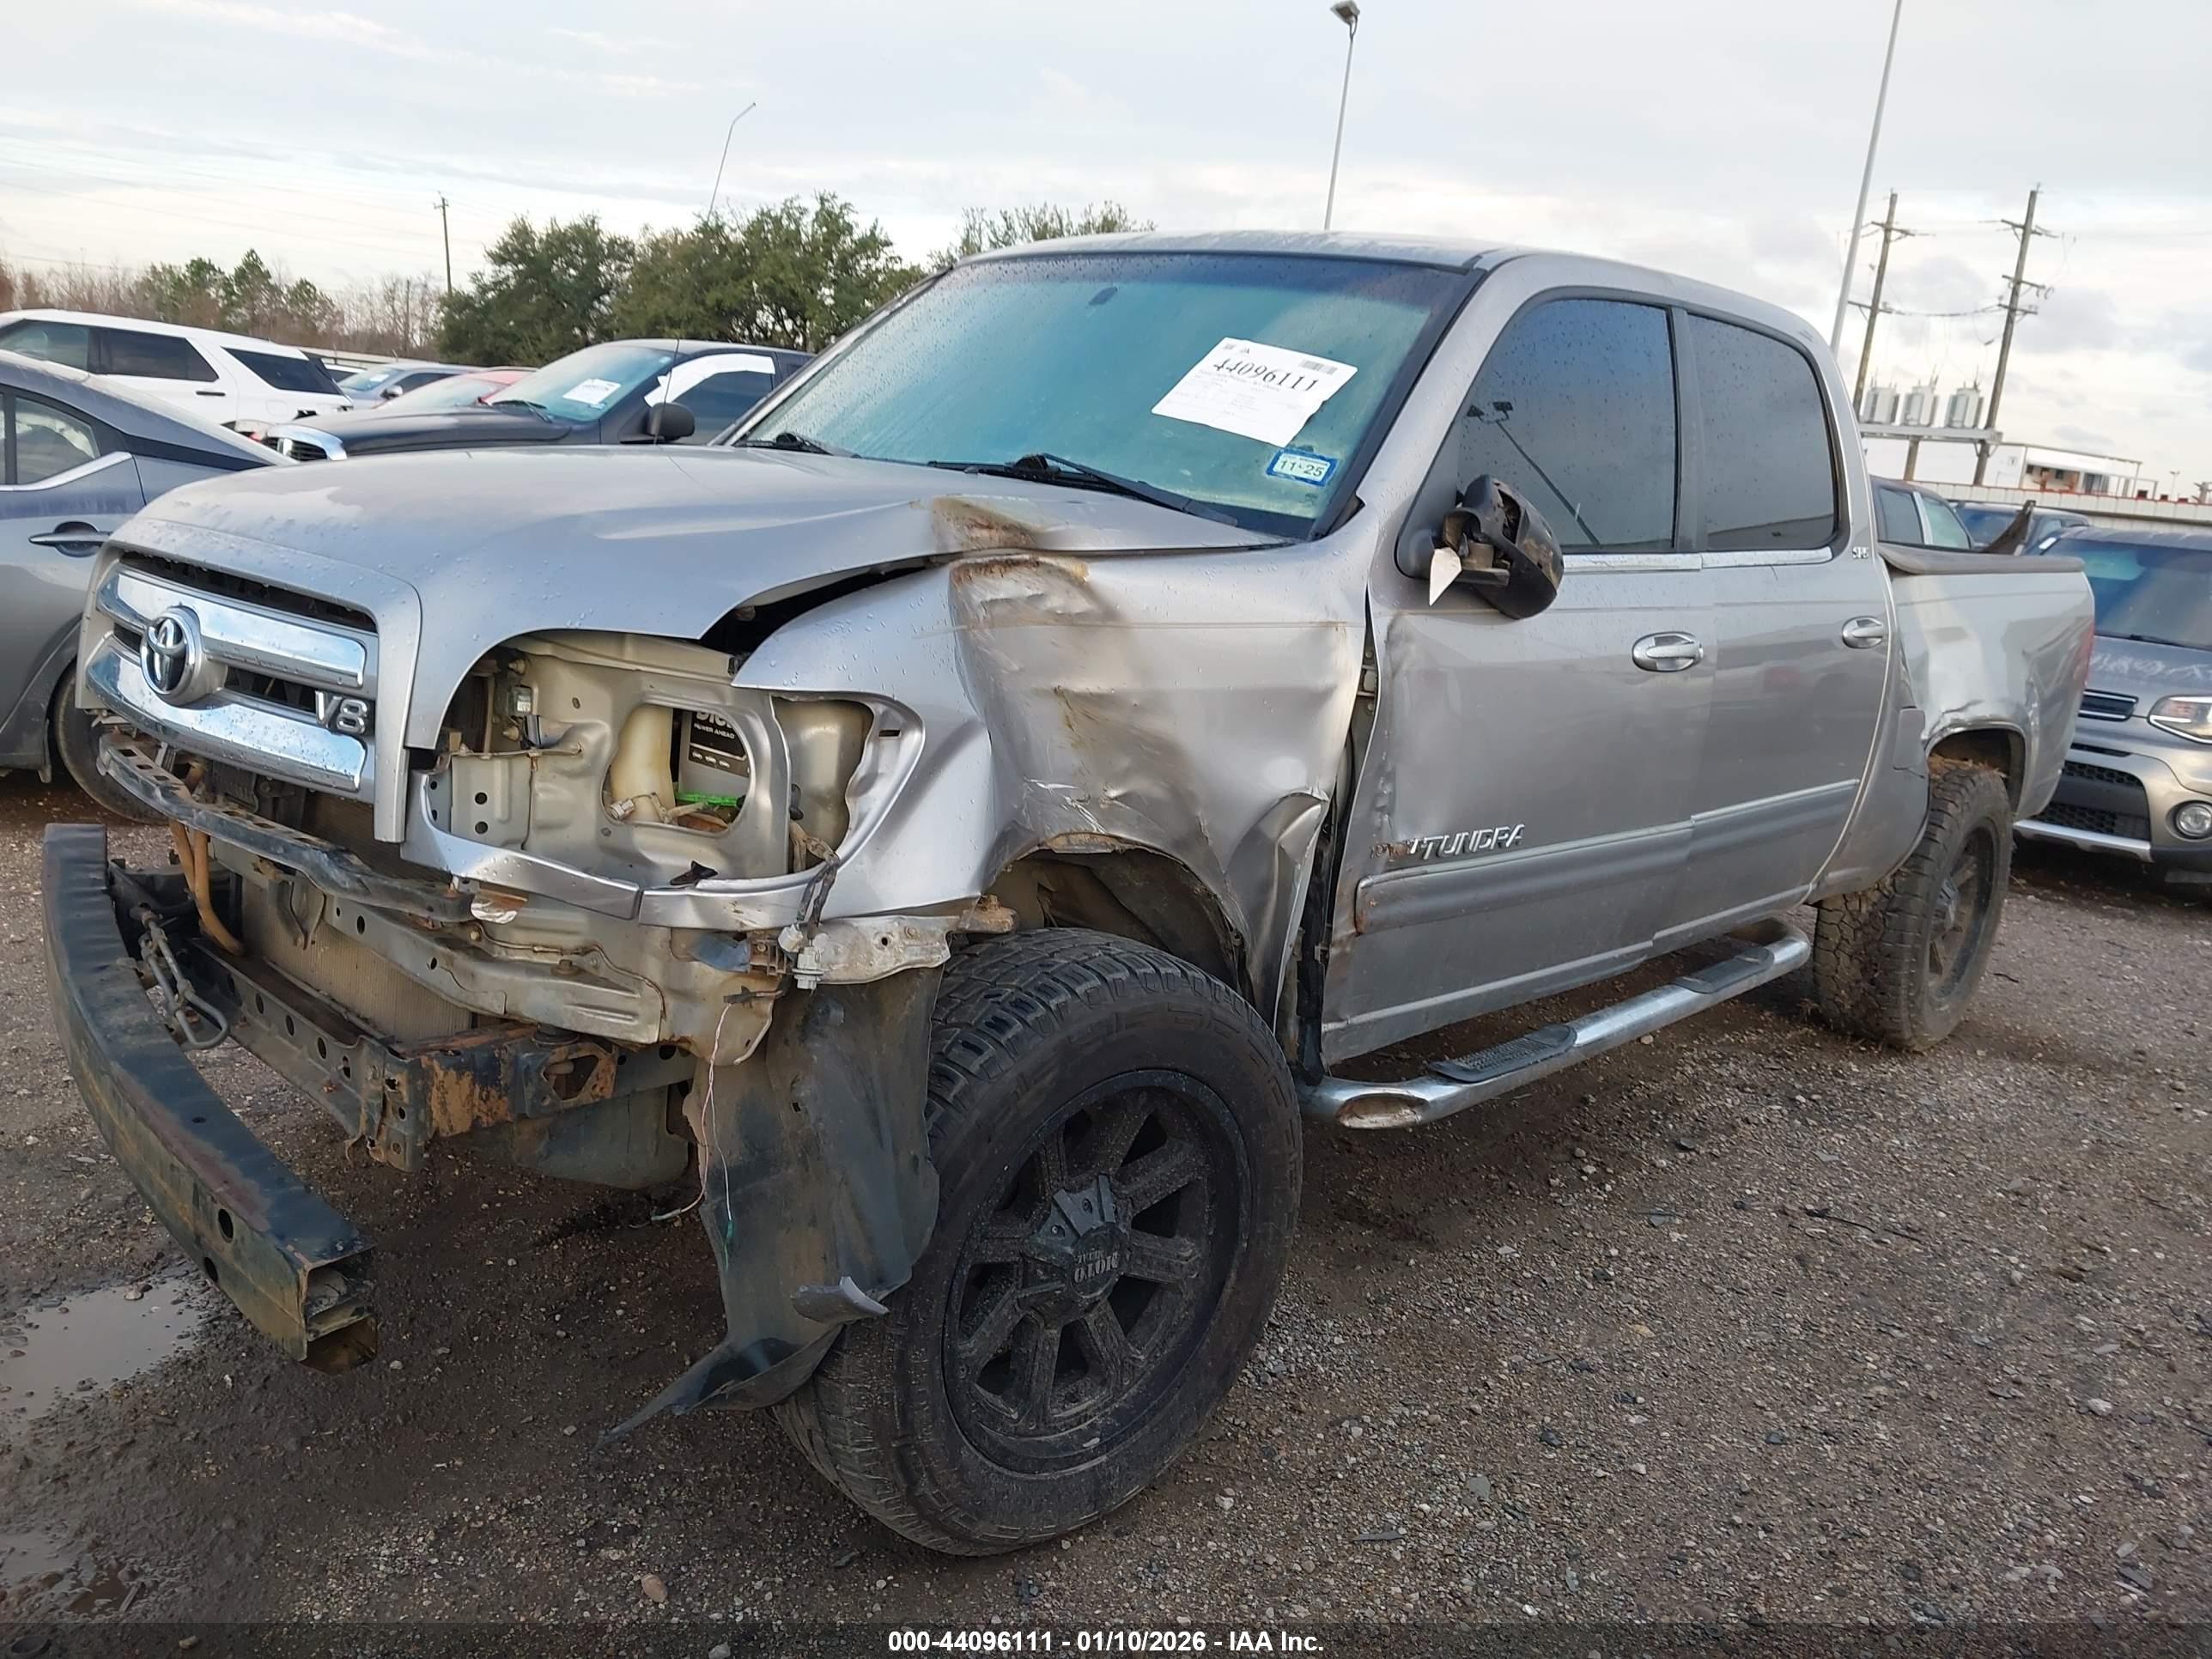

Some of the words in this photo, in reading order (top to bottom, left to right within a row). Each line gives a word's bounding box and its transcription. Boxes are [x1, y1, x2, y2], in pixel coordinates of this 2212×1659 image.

[1213, 357, 1318, 392] 44096111
[315, 690, 368, 733] V8
[1421, 823, 1525, 860] TUNDRA
